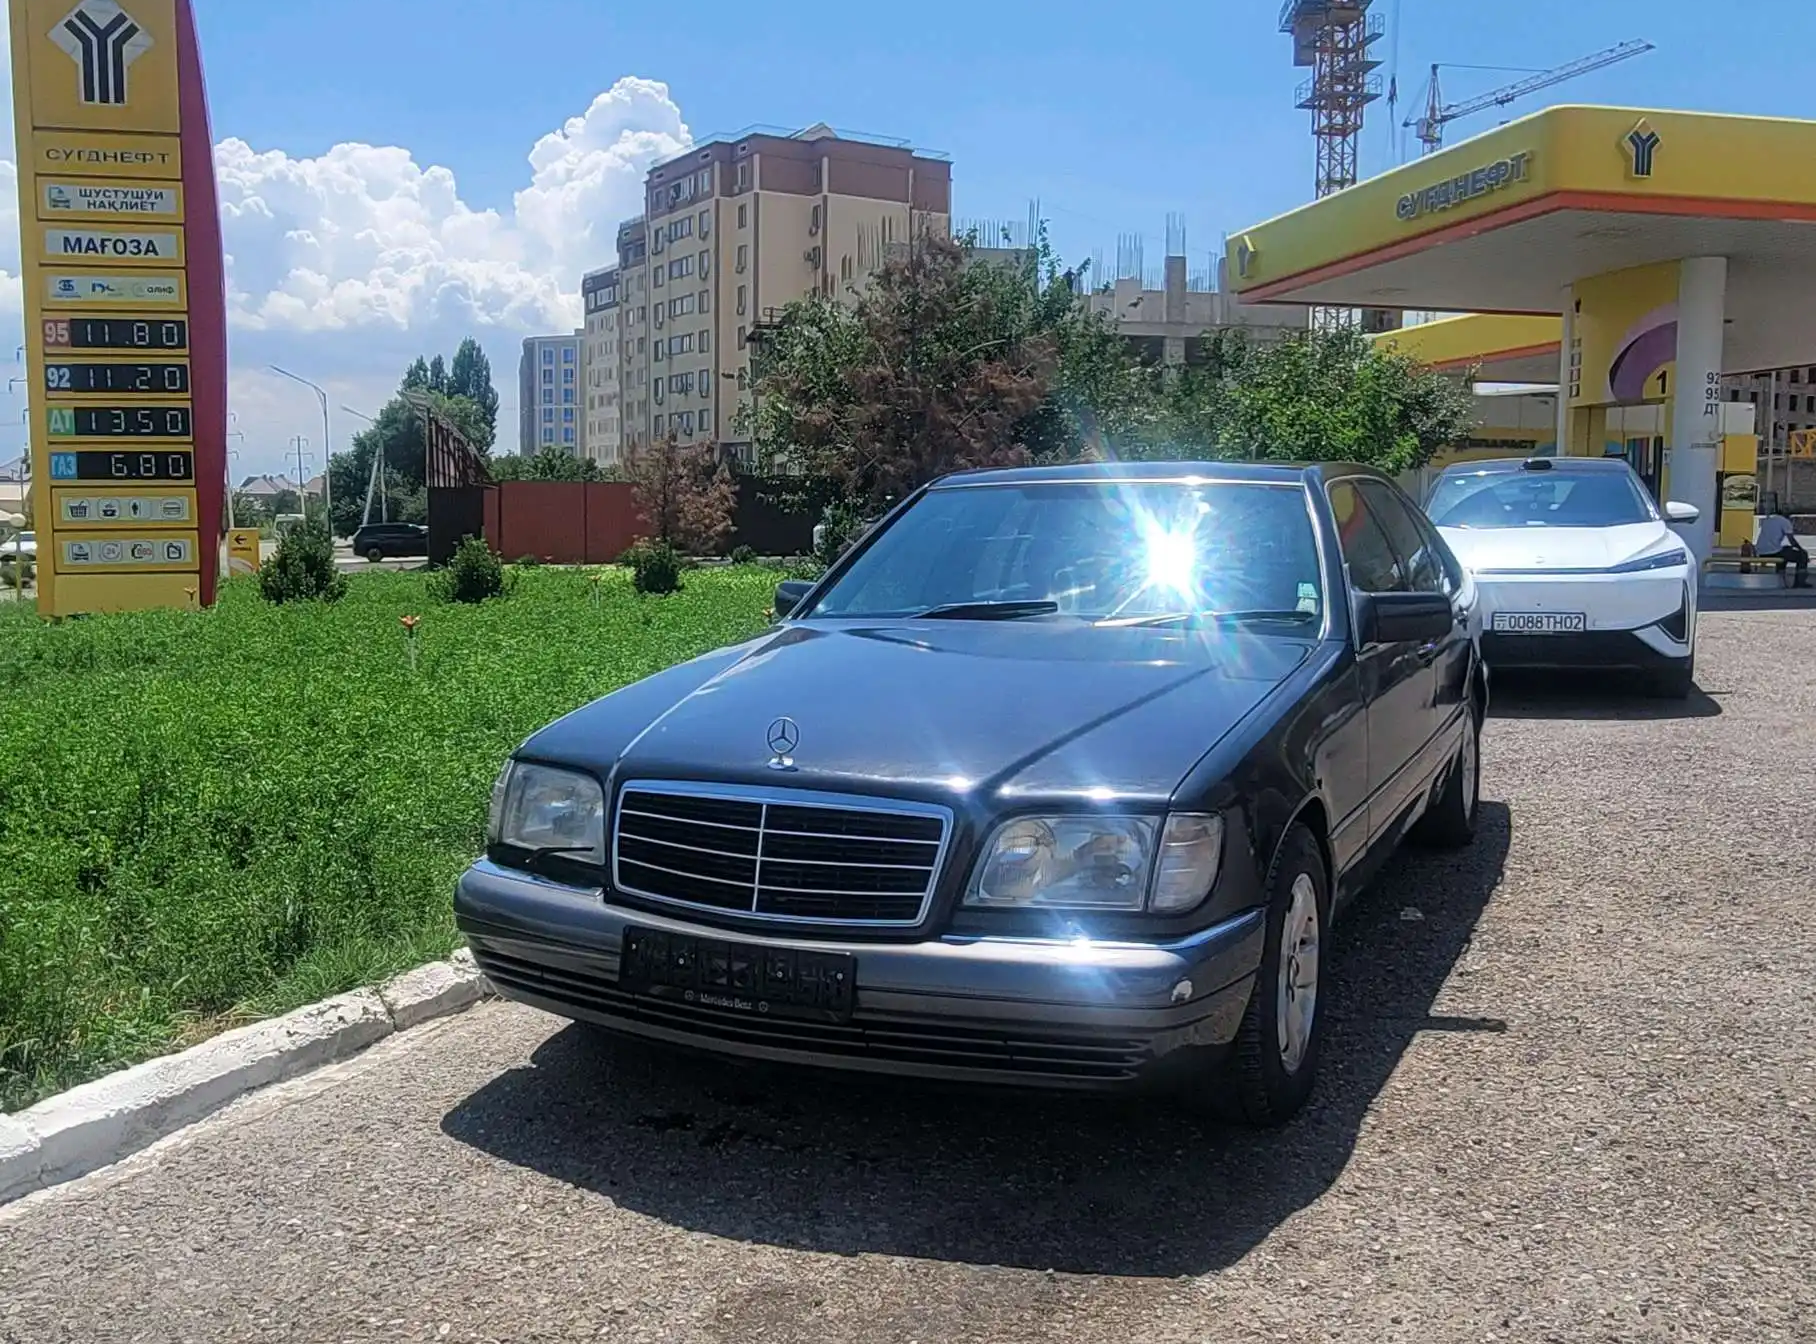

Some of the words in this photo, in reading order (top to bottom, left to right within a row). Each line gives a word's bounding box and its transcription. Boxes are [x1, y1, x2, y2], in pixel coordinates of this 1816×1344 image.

[46, 148, 169, 164] СУГДНЕФТ
[63, 236, 159, 256] МАҒОЗА
[45, 322, 69, 343] 95
[87, 322, 179, 346] 11.80
[47, 367, 71, 388] 92
[89, 367, 180, 390] 11.20
[1656, 370, 1667, 394] 1
[1706, 371, 1720, 385] 92
[1705, 387, 1719, 401] 95
[1703, 403, 1719, 417] ДТ
[91, 410, 182, 433] 13.50
[111, 454, 185, 476] 6.80
[1508, 615, 1582, 630] 0088TH02
